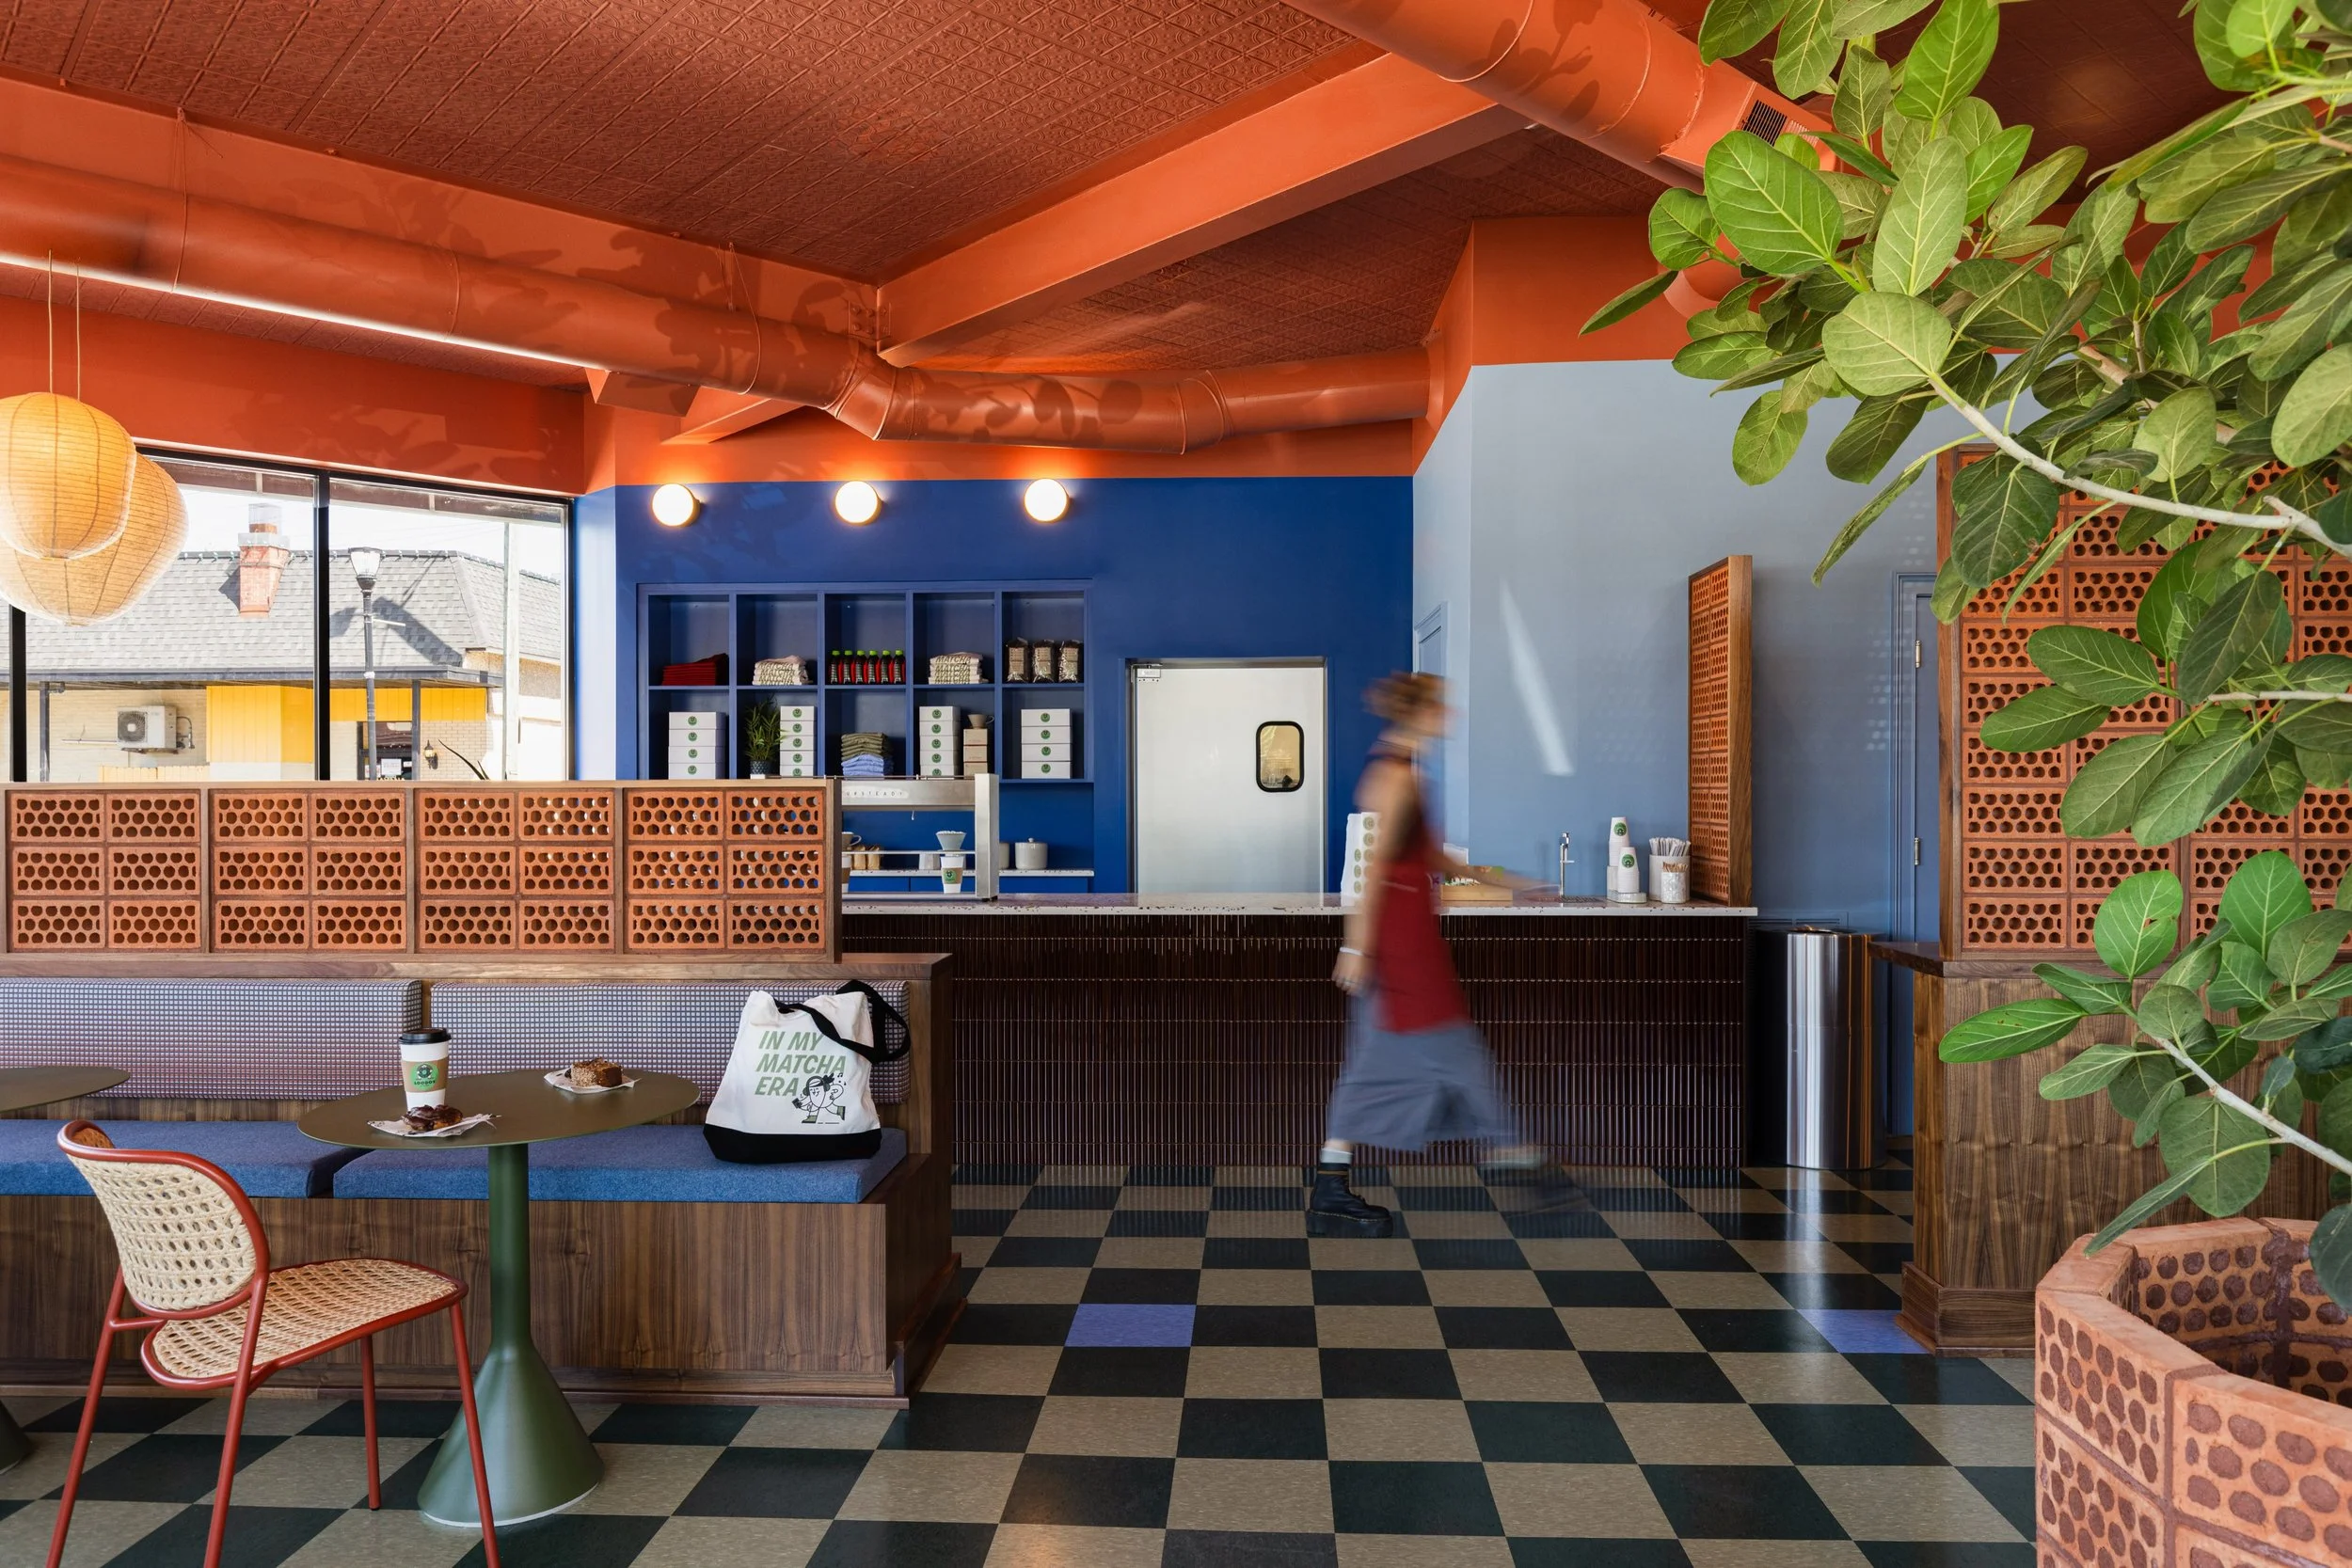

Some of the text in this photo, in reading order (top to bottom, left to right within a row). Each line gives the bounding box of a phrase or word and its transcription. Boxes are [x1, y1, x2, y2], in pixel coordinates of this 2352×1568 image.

[758, 1031, 824, 1051] IN MY
[755, 1053, 846, 1073] MATCHA
[755, 1076, 799, 1096] ERA
